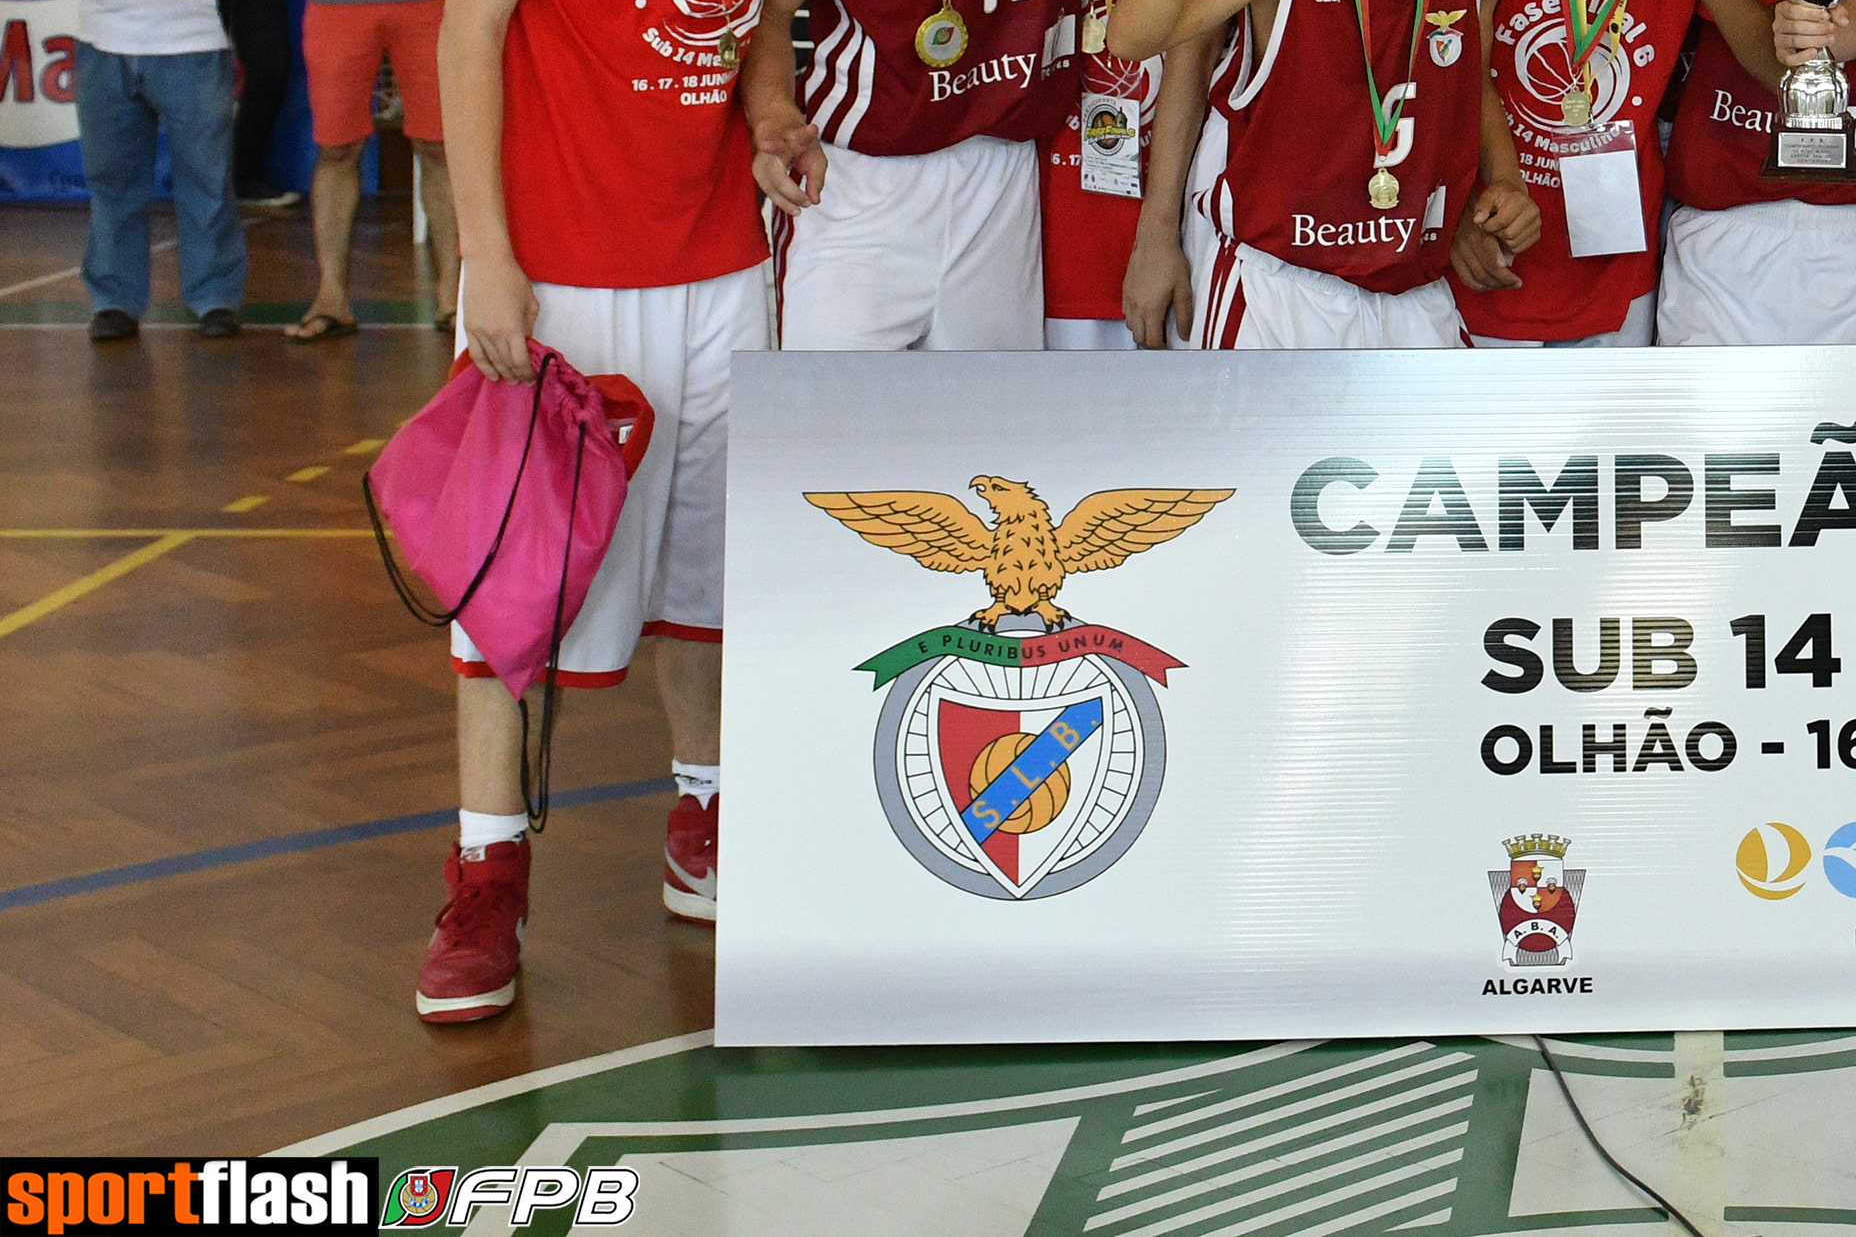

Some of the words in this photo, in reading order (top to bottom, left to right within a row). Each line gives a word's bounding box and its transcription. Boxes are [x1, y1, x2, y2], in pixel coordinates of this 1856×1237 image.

[643, 27, 673, 58] Sub
[673, 47, 696, 65] 14
[929, 52, 1037, 102] Beauty
[680, 89, 727, 105] OLHÃO
[1291, 214, 1416, 253] Beauty
[917, 641, 929, 654] E
[942, 634, 1046, 660] PLURIBUS
[1057, 634, 1124, 654] UNUM
[1480, 616, 1698, 694] SUB
[1729, 612, 1842, 689] 14
[1480, 706, 1738, 777] OLHÃO
[1482, 976, 1594, 996] ALGARVE
